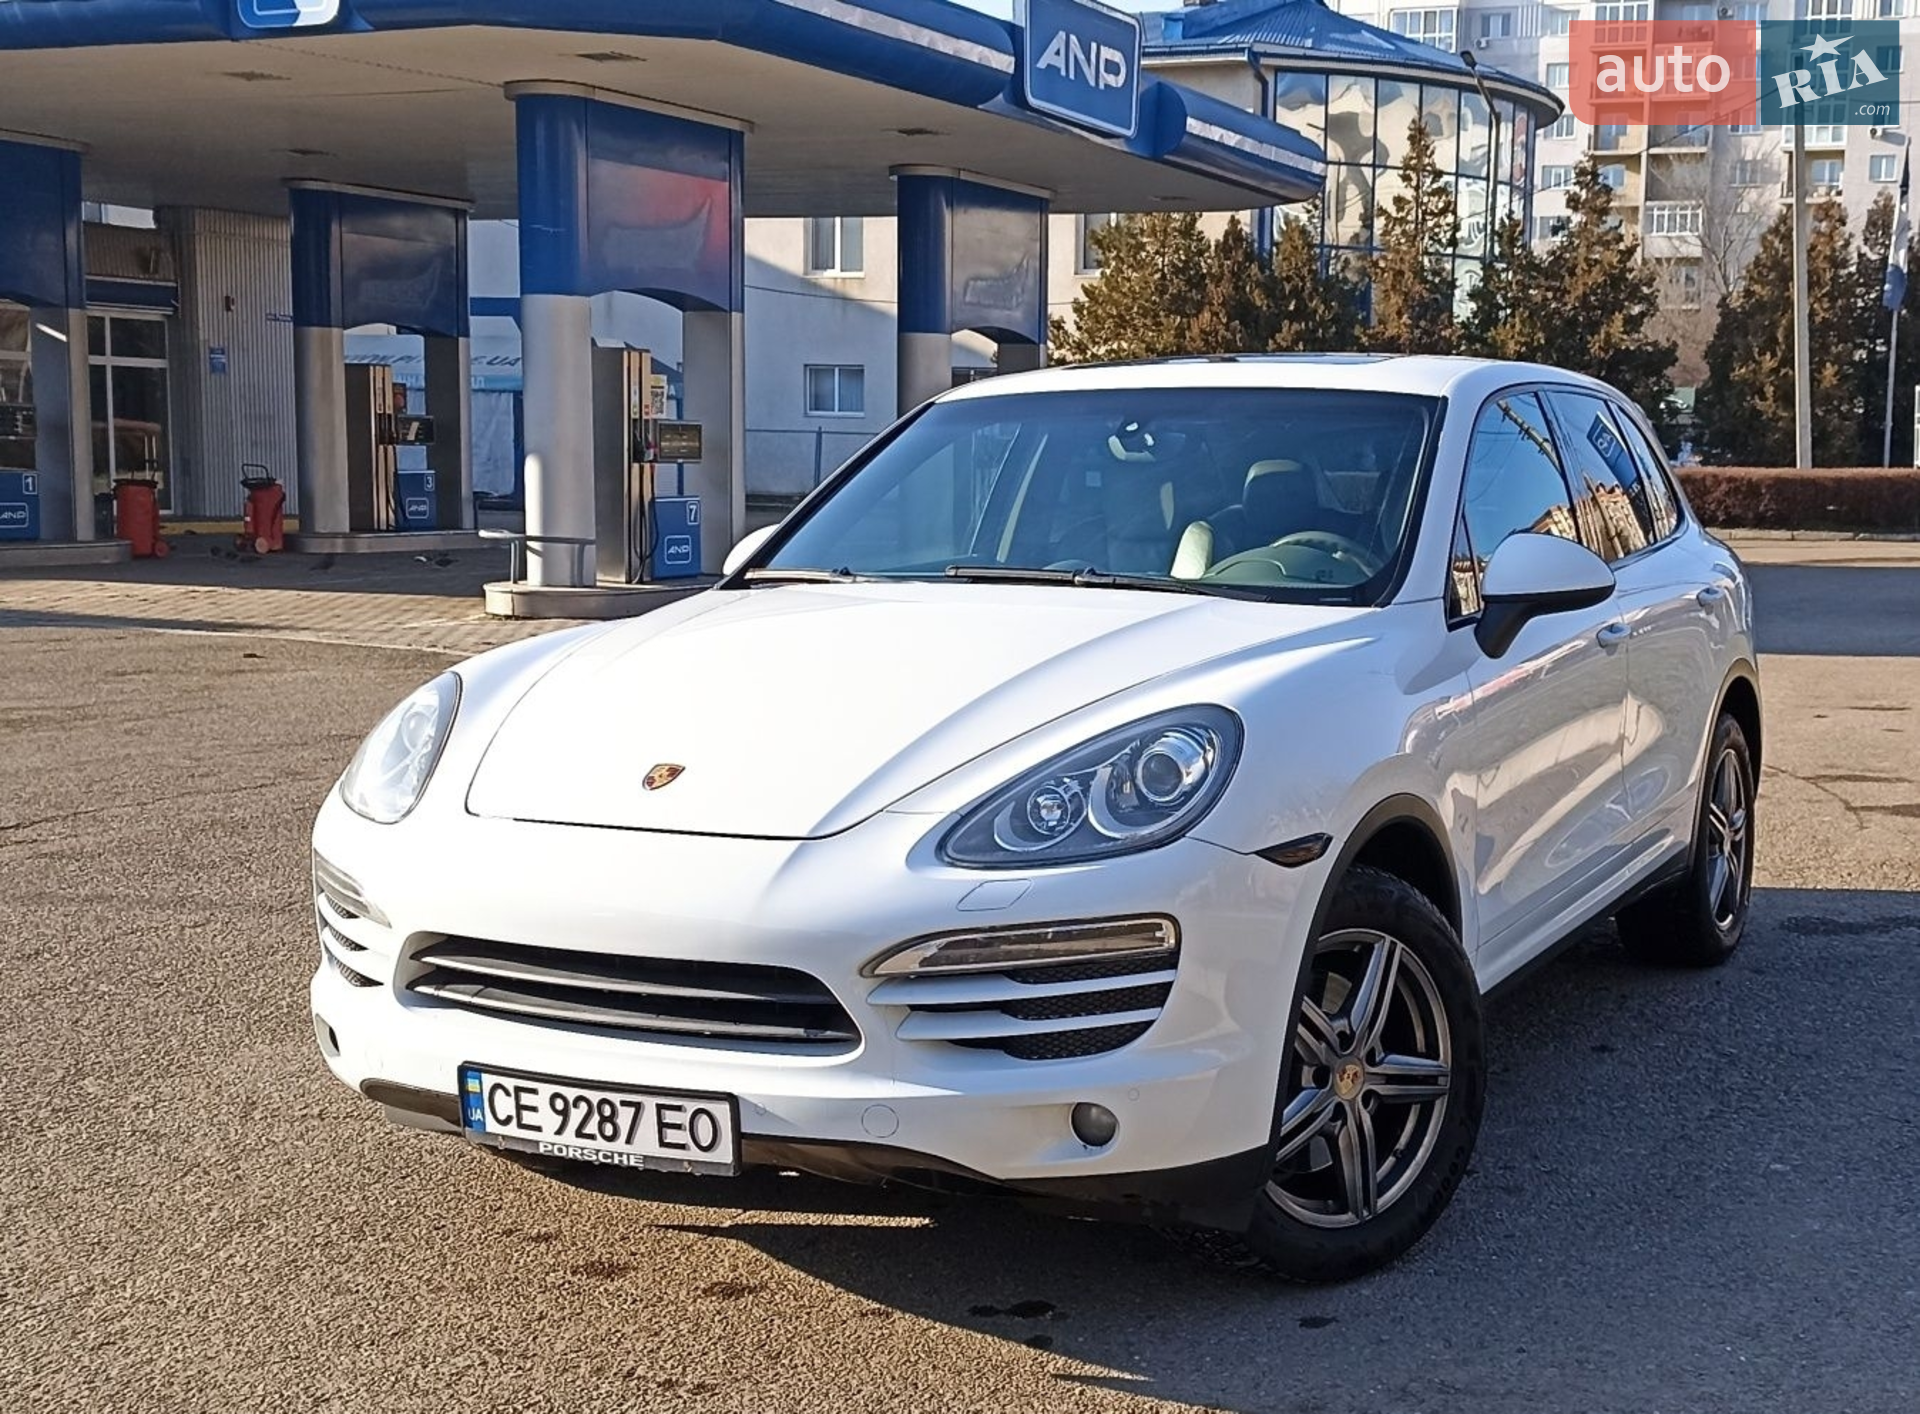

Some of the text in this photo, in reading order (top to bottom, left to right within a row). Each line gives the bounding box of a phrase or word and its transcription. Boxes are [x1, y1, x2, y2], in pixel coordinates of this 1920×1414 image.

[1036, 30, 1127, 90] ANP
[25, 476, 34, 491] 1
[426, 476, 433, 489] 3
[689, 505, 697, 521] 7
[667, 543, 690, 554] ANP
[468, 1107, 484, 1122] UA
[488, 1082, 720, 1153] CE 9287 EO
[538, 1141, 645, 1168] PORSCHE
